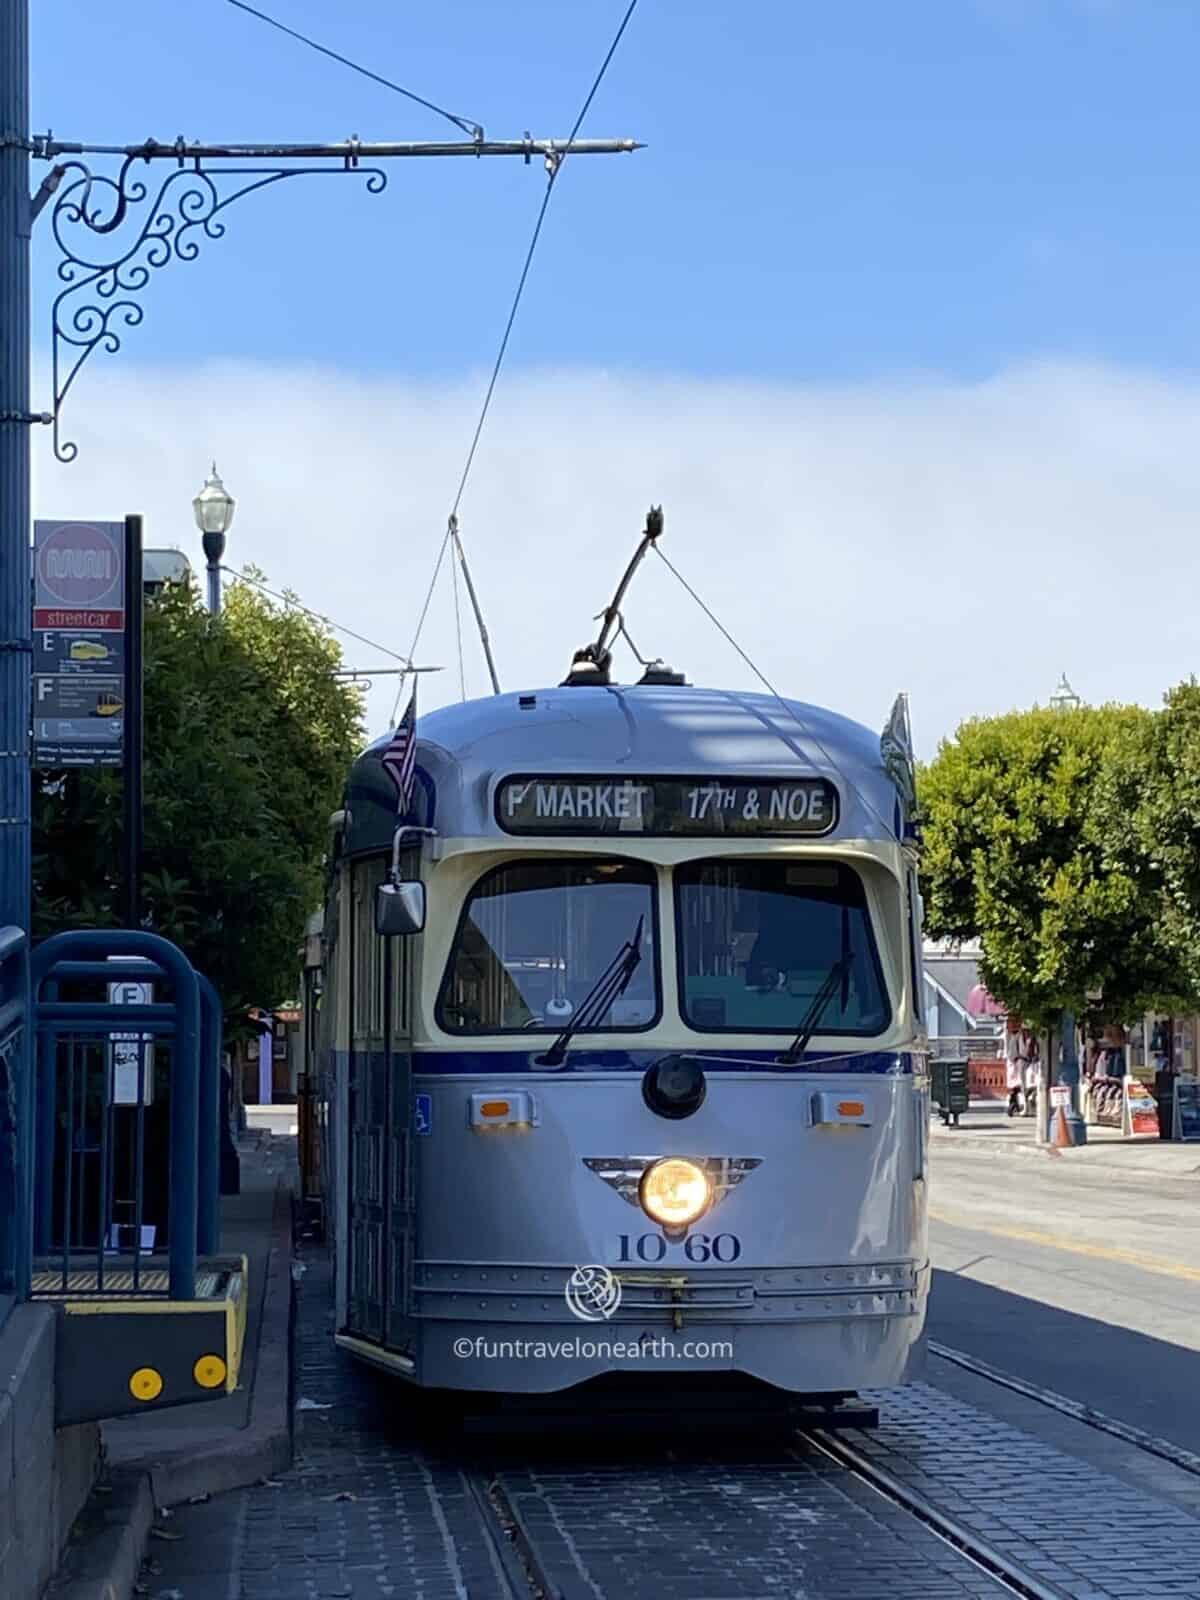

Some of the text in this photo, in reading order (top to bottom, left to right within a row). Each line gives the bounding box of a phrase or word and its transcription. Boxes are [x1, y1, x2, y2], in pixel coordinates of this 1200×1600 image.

[48, 610, 110, 626] streetcar
[43, 633, 54, 651] E
[38, 679, 53, 701] F
[535, 784, 648, 818] MARKET
[743, 790, 759, 819] &
[768, 789, 825, 820] NOE
[616, 1232, 741, 1263] 1060
